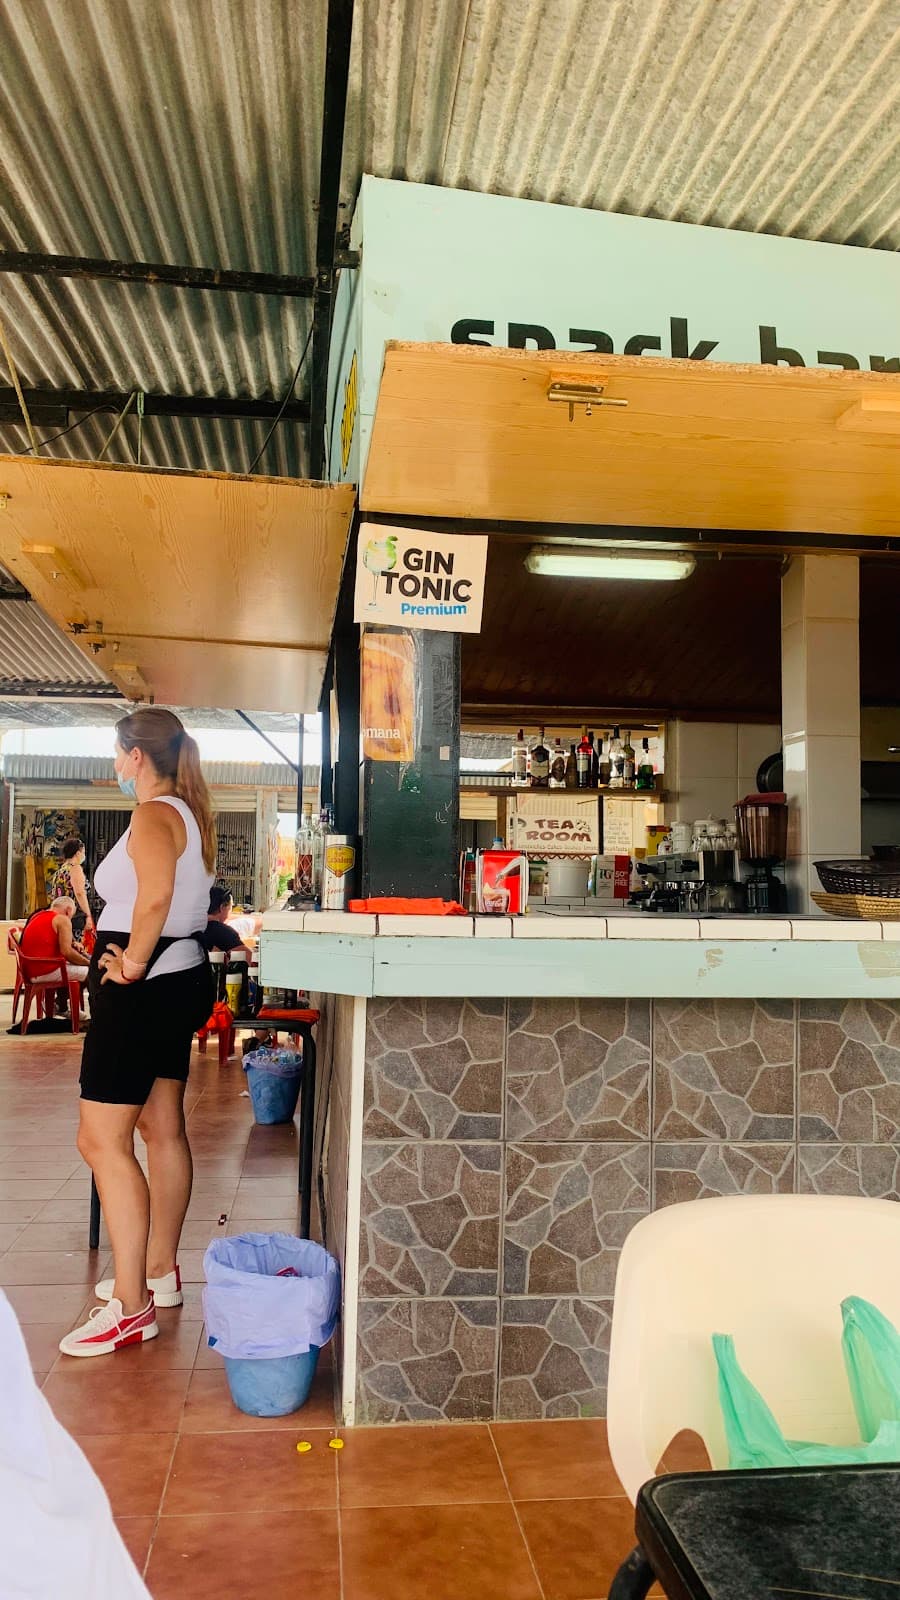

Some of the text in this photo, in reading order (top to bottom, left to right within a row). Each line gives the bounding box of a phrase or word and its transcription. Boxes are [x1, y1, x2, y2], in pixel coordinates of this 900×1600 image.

[402, 547, 455, 575] GIN
[381, 570, 473, 603] TONIC
[401, 602, 467, 616] Premium
[535, 818, 575, 830] TEA
[525, 830, 592, 842] ROOM
